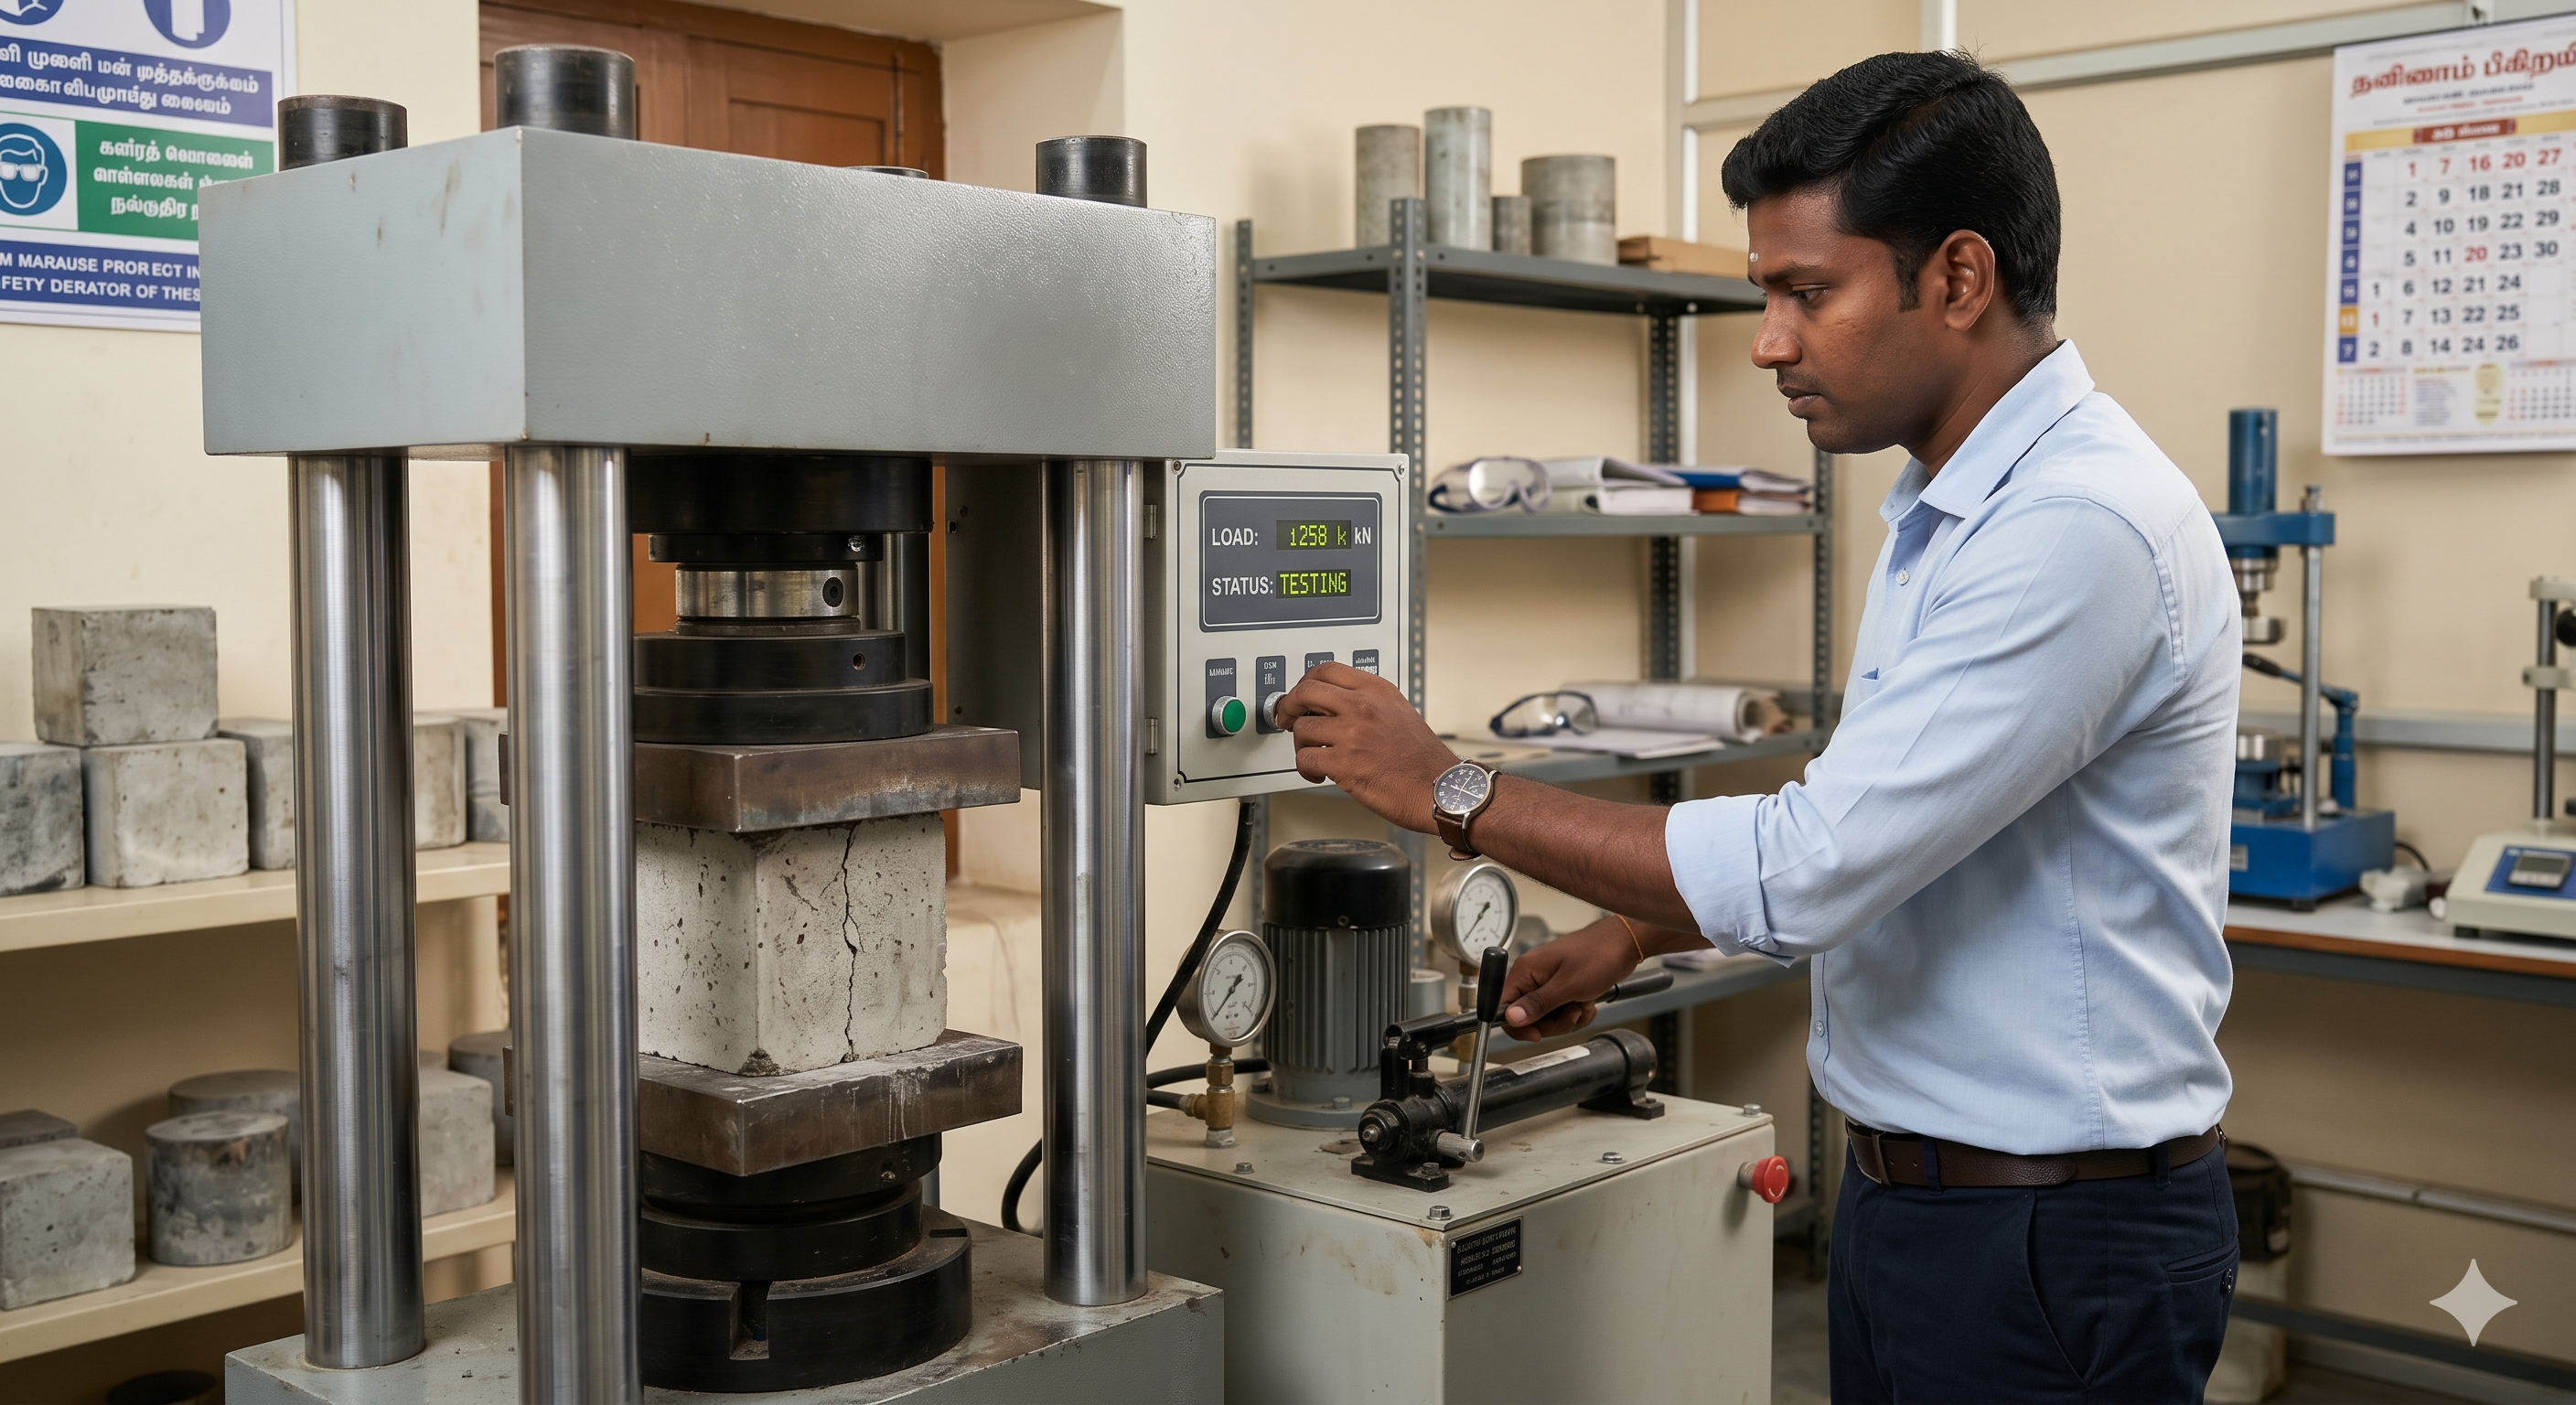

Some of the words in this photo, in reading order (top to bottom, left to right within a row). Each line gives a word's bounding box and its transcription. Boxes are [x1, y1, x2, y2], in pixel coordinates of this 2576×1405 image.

[2409, 162, 2416, 177] 1
[2439, 157, 2451, 175] 7
[2469, 155, 2491, 172] 16
[2503, 151, 2526, 168] 20
[2538, 147, 2562, 166] 27
[2406, 191, 2417, 208] 2
[2439, 188, 2450, 204] 9
[2468, 184, 2490, 201] 18
[2502, 182, 2522, 198] 21
[2538, 179, 2560, 197] 28
[2405, 221, 2416, 236] 4
[2434, 218, 2454, 234] 10
[2468, 215, 2488, 231] 19
[2501, 212, 2523, 229] 22
[2536, 209, 2560, 226] 29
[18, 253, 98, 273] MARAUSE
[2404, 251, 2416, 267] 5
[2433, 249, 2452, 263] 11
[2464, 245, 2487, 263] 20
[2499, 242, 2522, 260] 23
[2534, 241, 2559, 258] 30
[0, 276, 45, 292] FETY
[50, 279, 132, 297] DERATOR
[135, 284, 157, 299] OF
[2374, 283, 2380, 298] 1
[2403, 280, 2414, 296] 6
[2432, 278, 2453, 294] 12
[2463, 275, 2485, 293] 21
[2498, 273, 2521, 291] 24
[2372, 312, 2378, 327] 1
[2401, 309, 2413, 326] 7
[2431, 307, 2451, 325] 13
[2463, 306, 2485, 323] 22
[2496, 304, 2519, 321] 25
[2369, 341, 2379, 358] 2
[2401, 339, 2412, 356] 8
[2431, 337, 2450, 354] 14
[2496, 334, 2519, 352] 26
[1212, 527, 1259, 546] LOAD:
[1354, 526, 1372, 544] kN
[1212, 576, 1273, 596] STATUS:
[1280, 573, 1347, 595] TESTING
